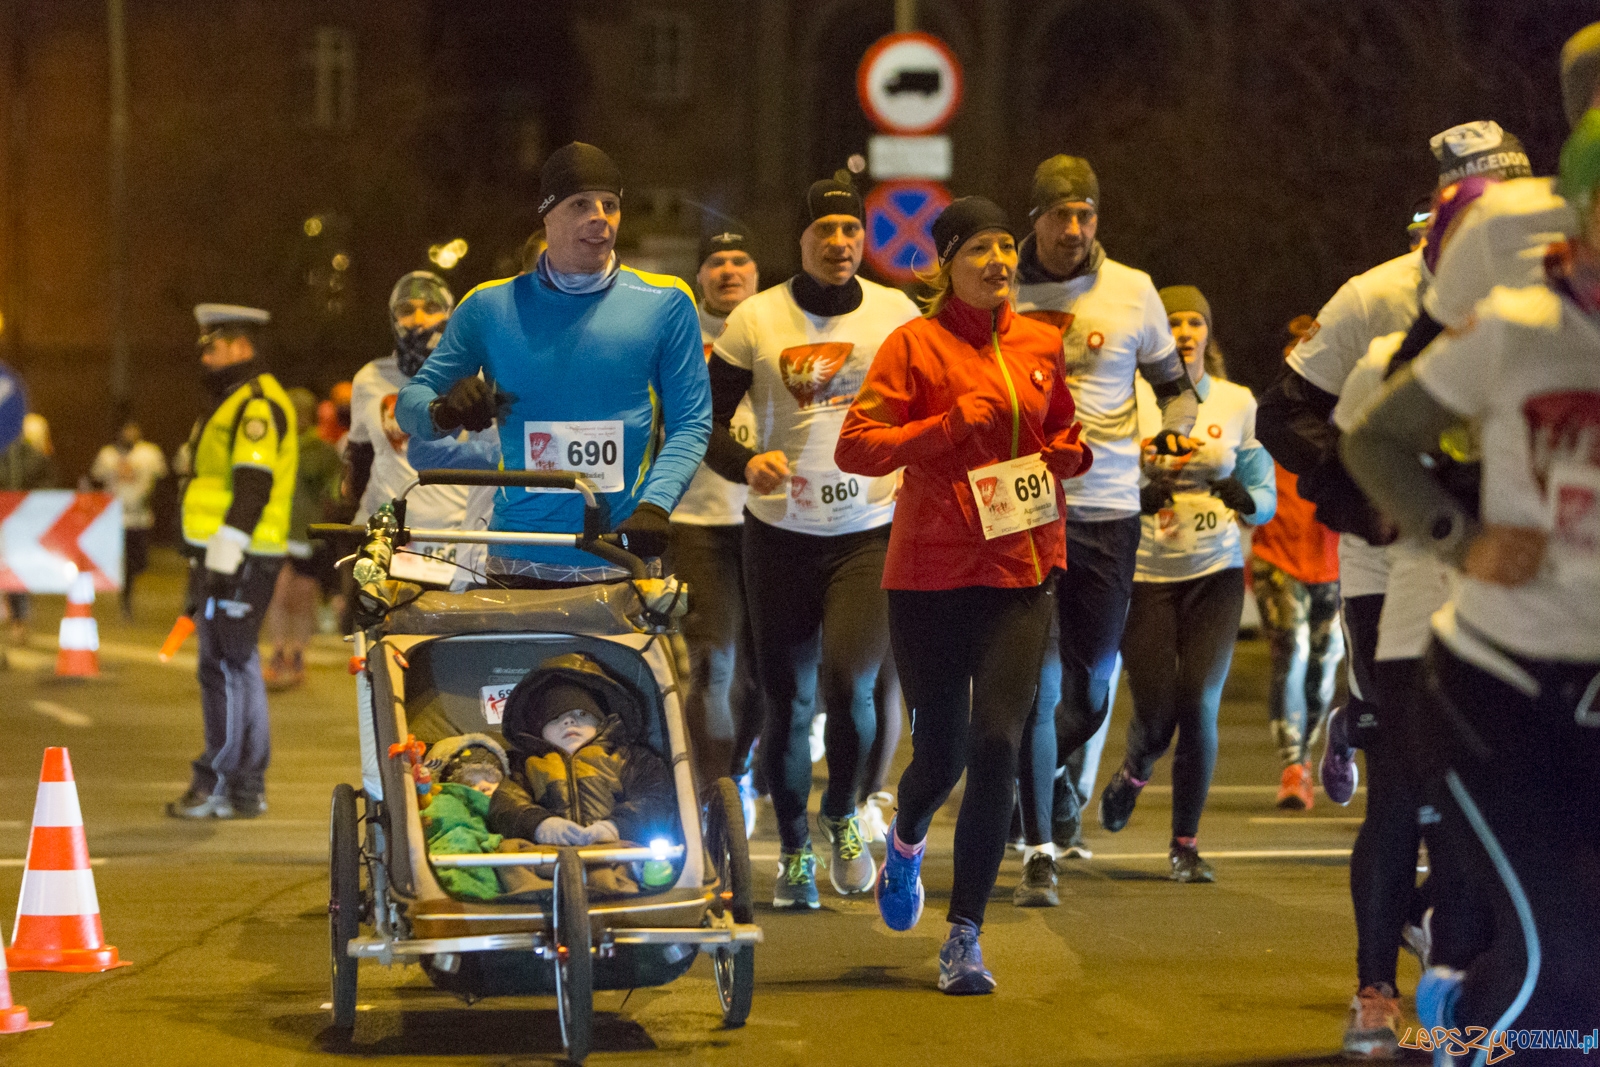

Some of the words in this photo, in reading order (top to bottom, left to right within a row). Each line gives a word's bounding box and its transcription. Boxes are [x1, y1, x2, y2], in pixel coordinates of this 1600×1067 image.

[567, 440, 617, 467] 690
[821, 478, 859, 504] 860
[1014, 470, 1051, 502] 691
[1193, 511, 1218, 532] 20
